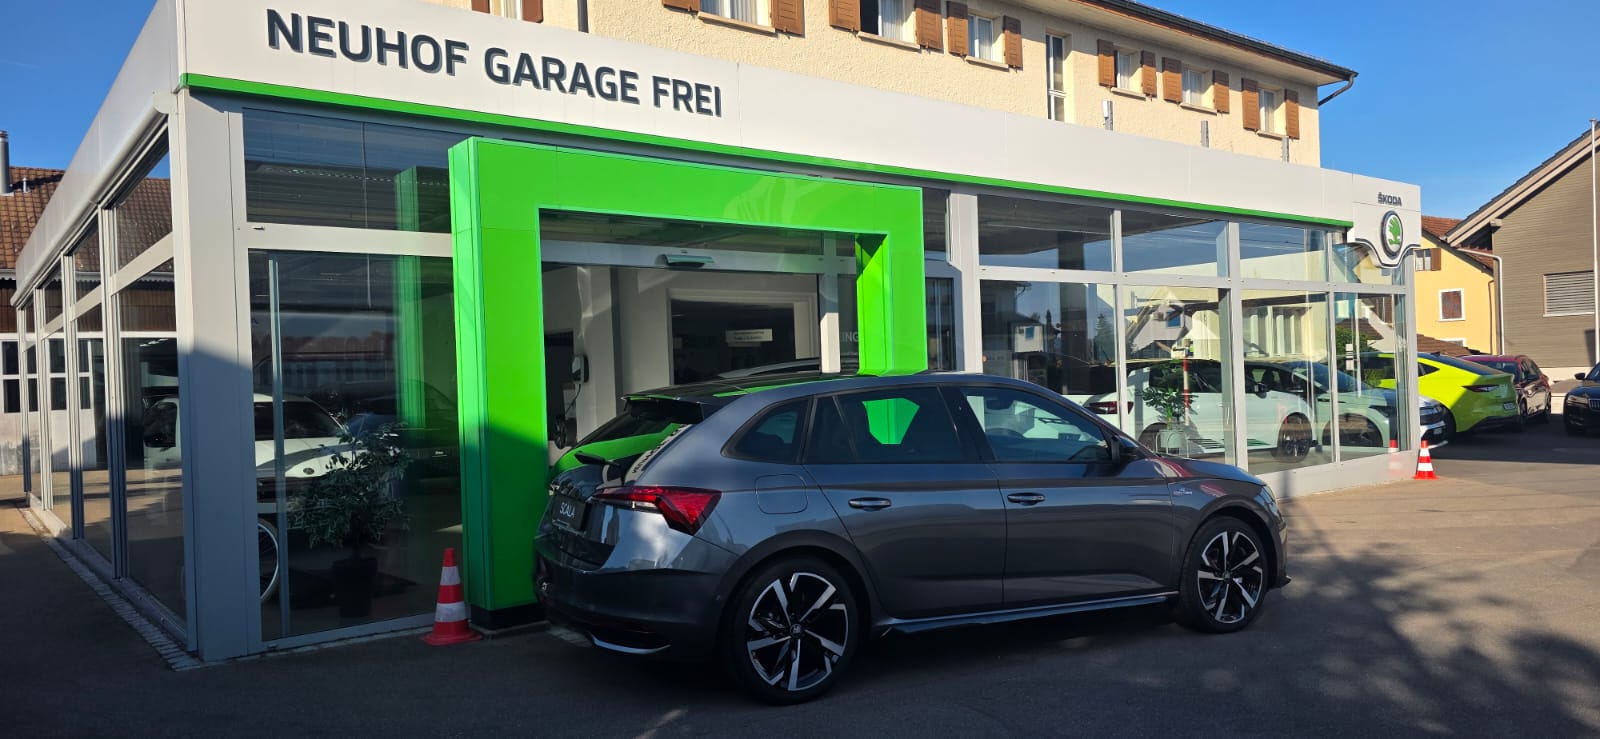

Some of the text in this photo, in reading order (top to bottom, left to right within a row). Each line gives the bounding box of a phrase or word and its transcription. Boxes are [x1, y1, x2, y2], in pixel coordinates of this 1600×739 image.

[267, 8, 722, 118] NEUHOF GARAGE FREI
[1377, 191, 1402, 207] ŠKODA
[839, 331, 859, 342] ING
[559, 501, 576, 518] SCALA
